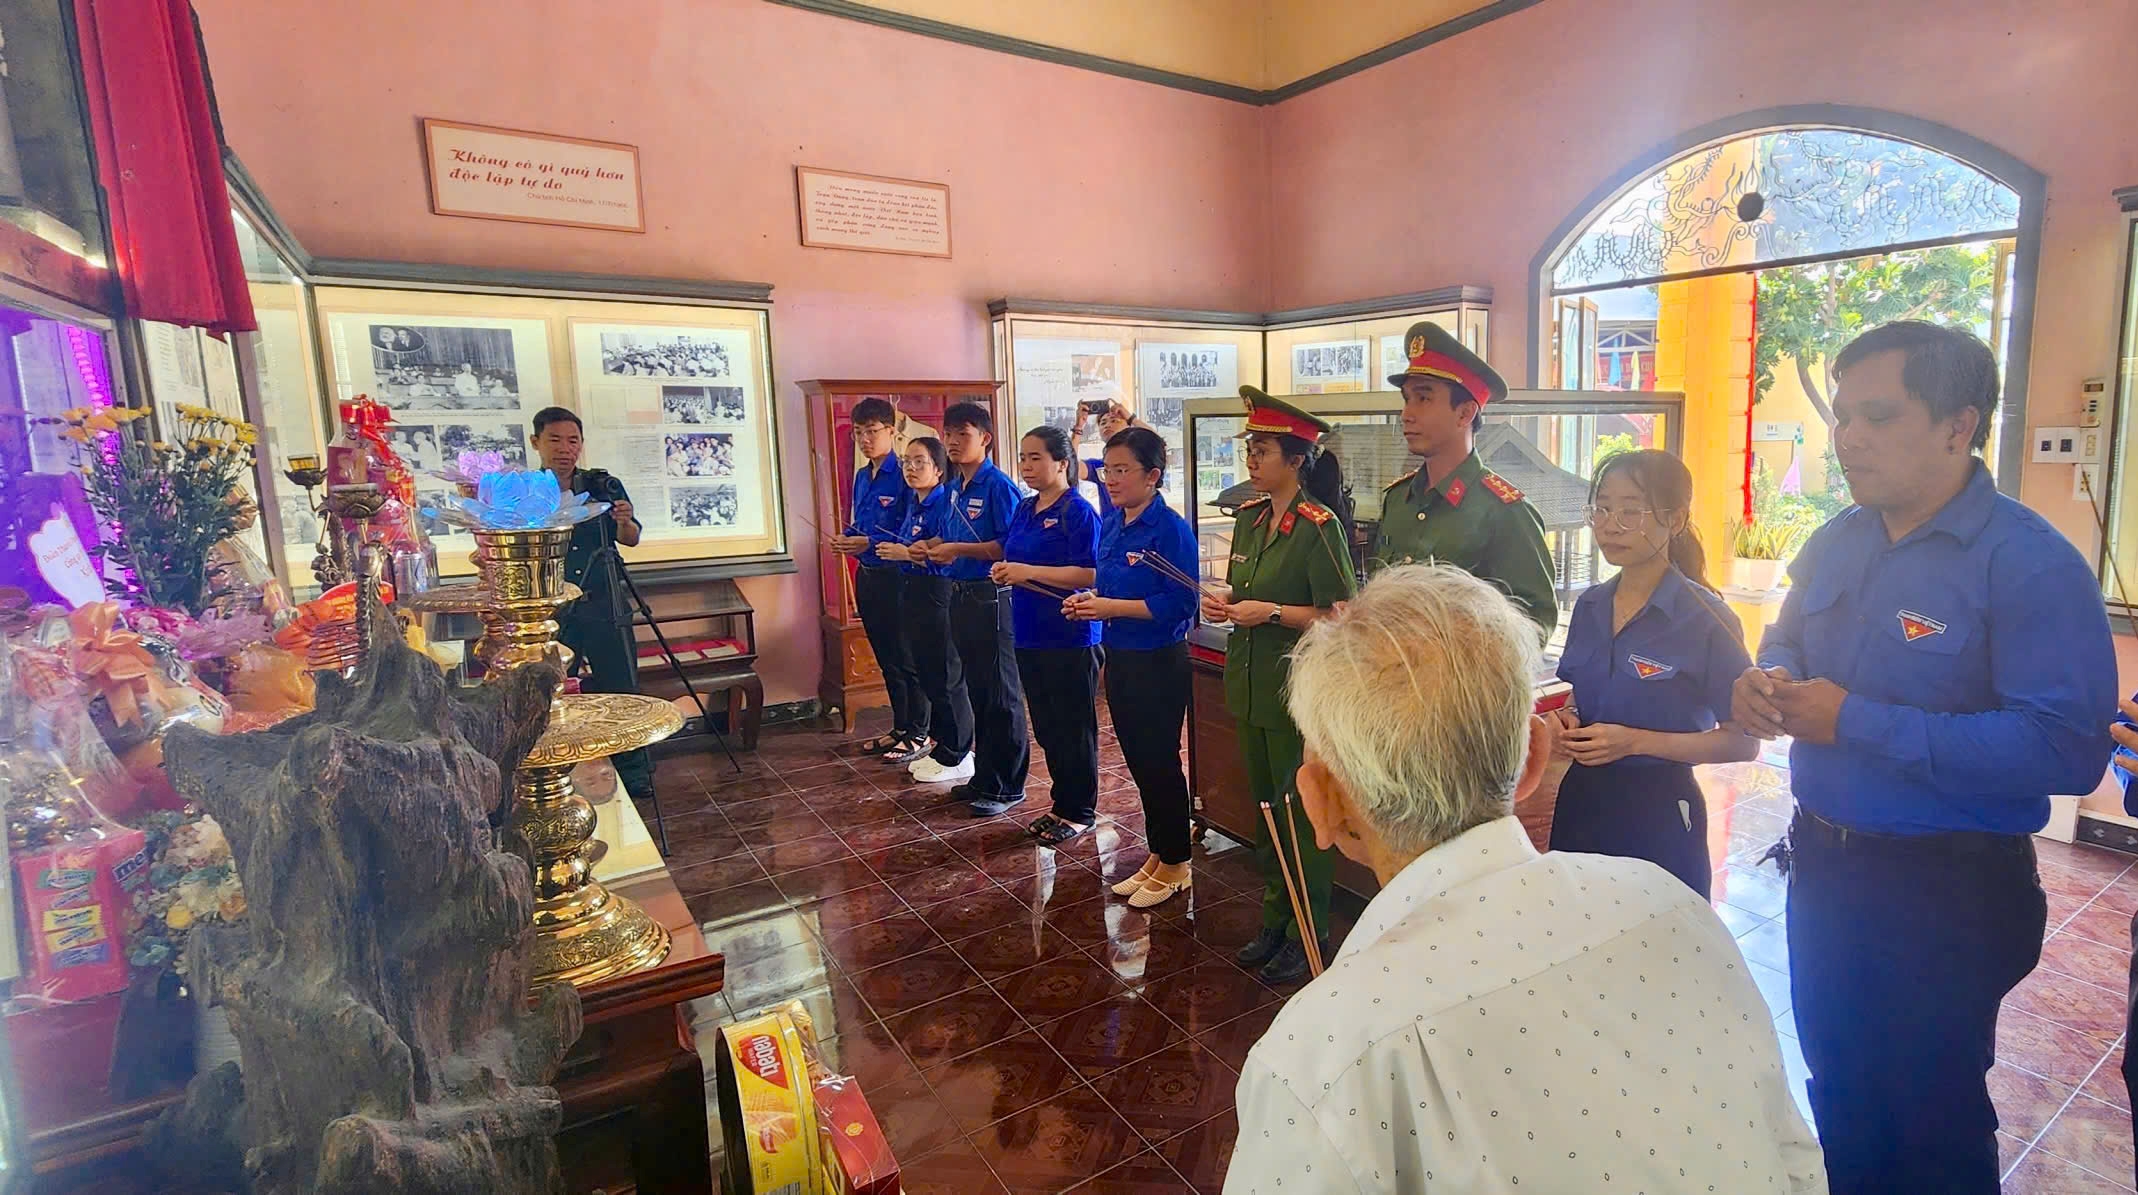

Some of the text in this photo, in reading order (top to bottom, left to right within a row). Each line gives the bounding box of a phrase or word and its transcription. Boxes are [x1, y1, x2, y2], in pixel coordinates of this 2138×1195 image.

[449, 149, 509, 169] Không
[538, 162, 554, 173] gì
[596, 167, 625, 181] hơn
[449, 167, 480, 183] độc
[543, 178, 563, 190] do
[752, 1035, 781, 1077] nabati
